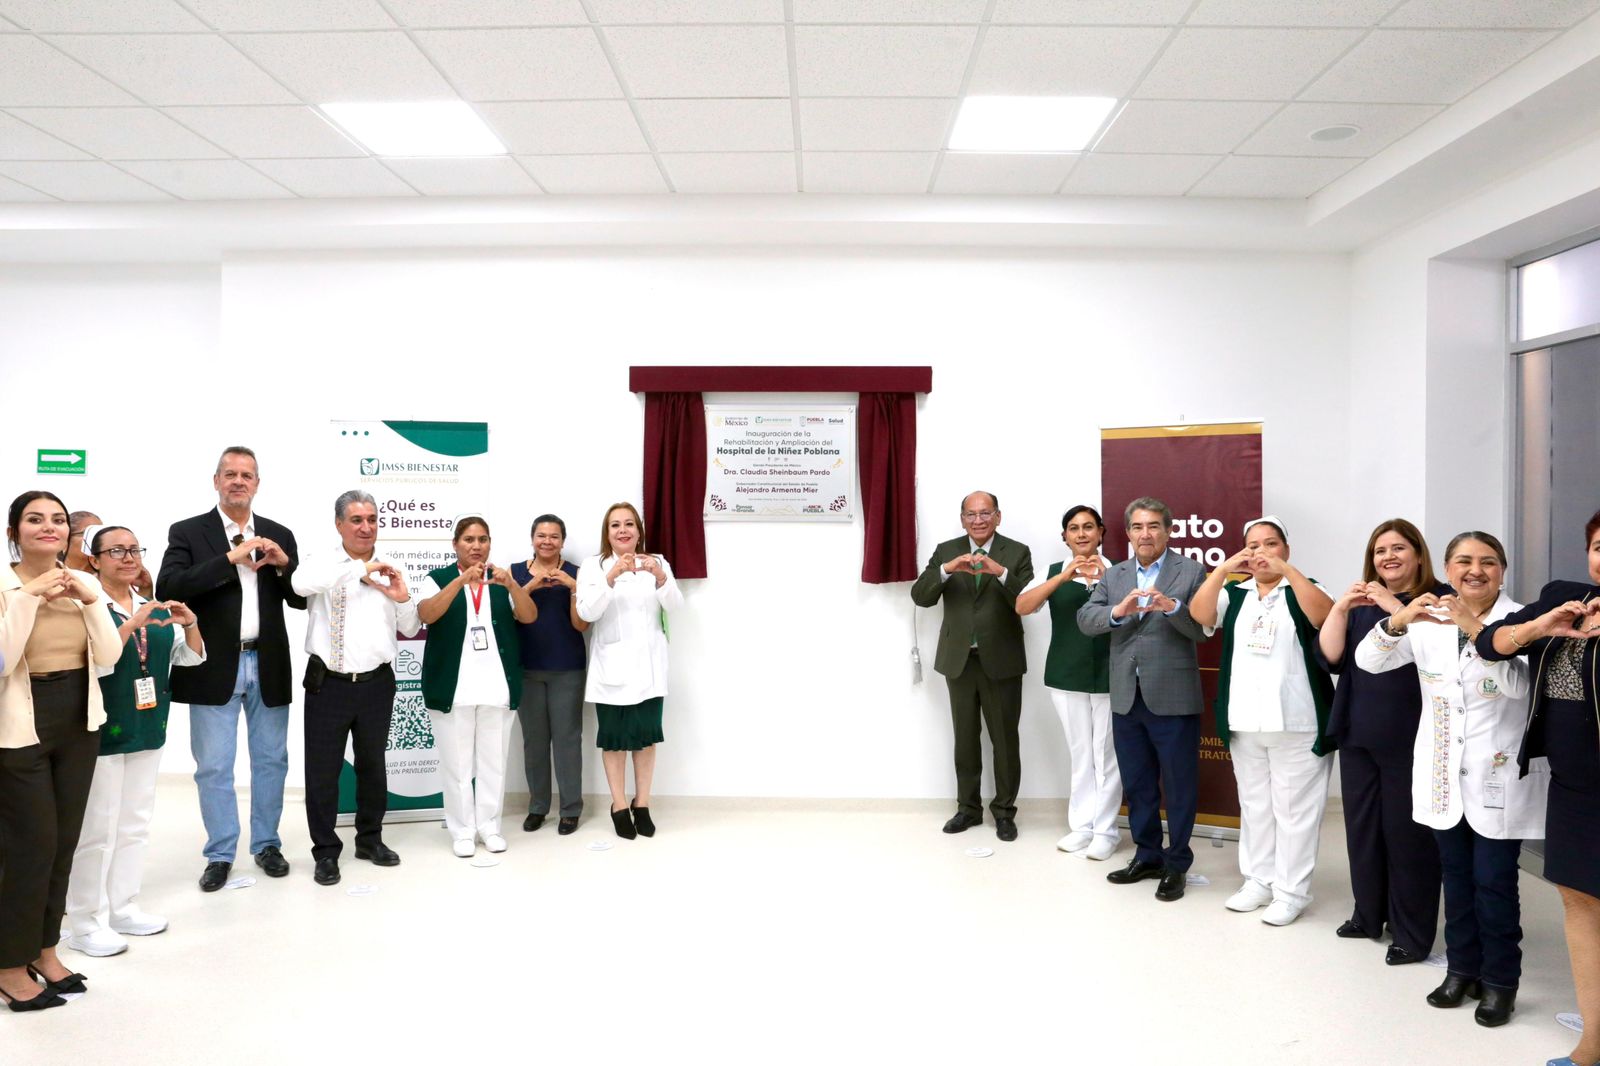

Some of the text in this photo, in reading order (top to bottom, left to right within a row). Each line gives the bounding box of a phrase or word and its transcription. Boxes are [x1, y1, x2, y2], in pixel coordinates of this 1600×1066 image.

[745, 430, 792, 438] Inauguración
[716, 447, 840, 456] Hospital de la Niñez Poblana
[381, 463, 459, 472] IMSS BIENESTAR
[736, 486, 770, 494] Alejandro
[379, 499, 436, 513] ¿Qué es
[391, 516, 453, 529] Bienesta
[1169, 514, 1224, 539] ato
[407, 551, 442, 559] médica
